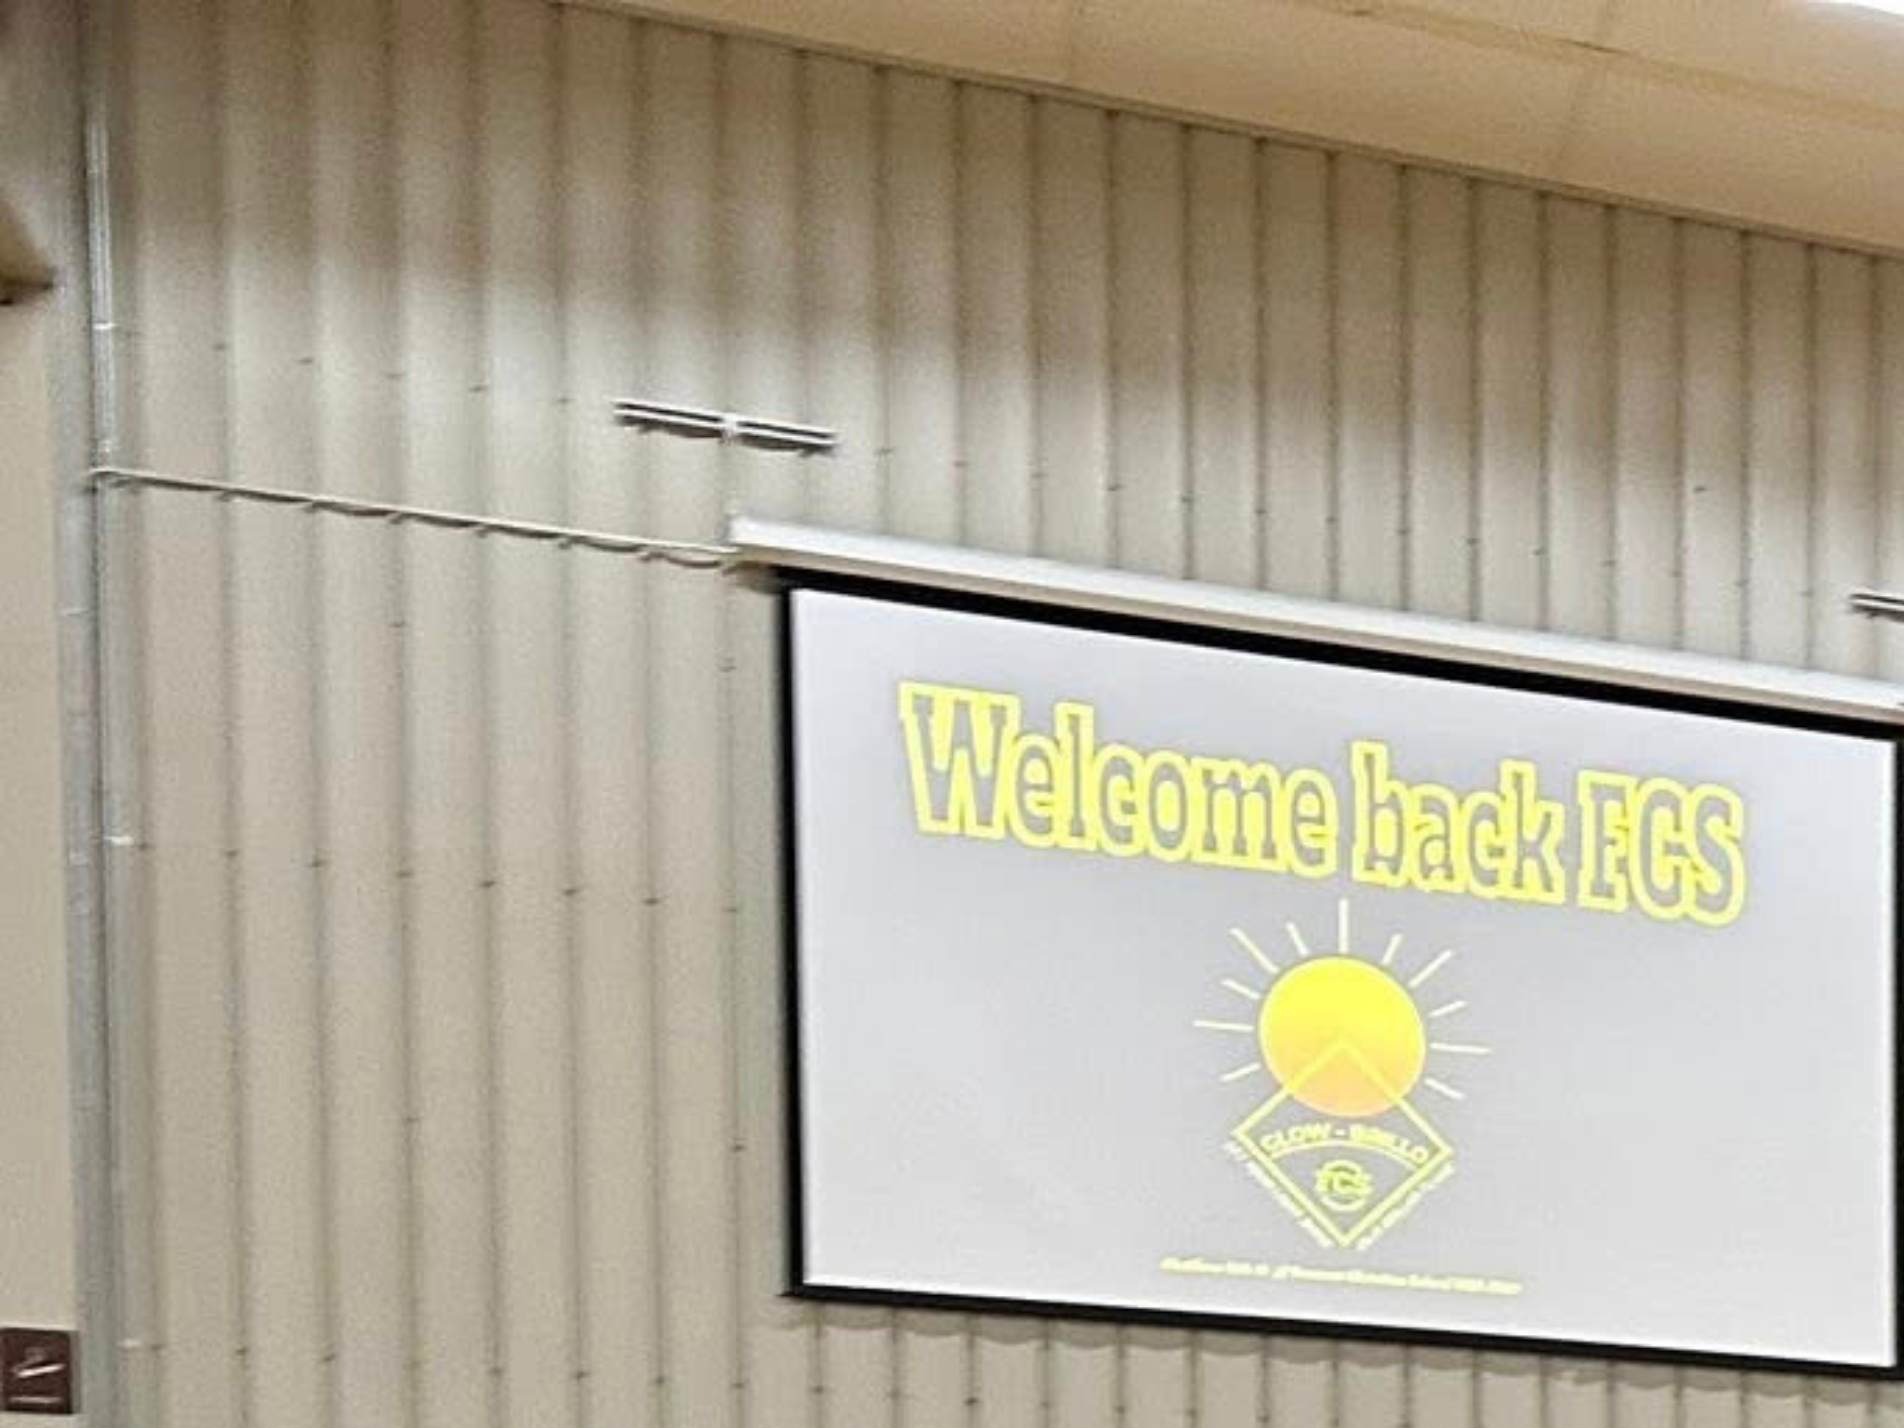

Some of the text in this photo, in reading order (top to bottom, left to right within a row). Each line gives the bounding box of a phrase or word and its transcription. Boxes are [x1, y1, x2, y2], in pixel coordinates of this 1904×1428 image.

[899, 682, 1745, 928] Welcome back FCS
